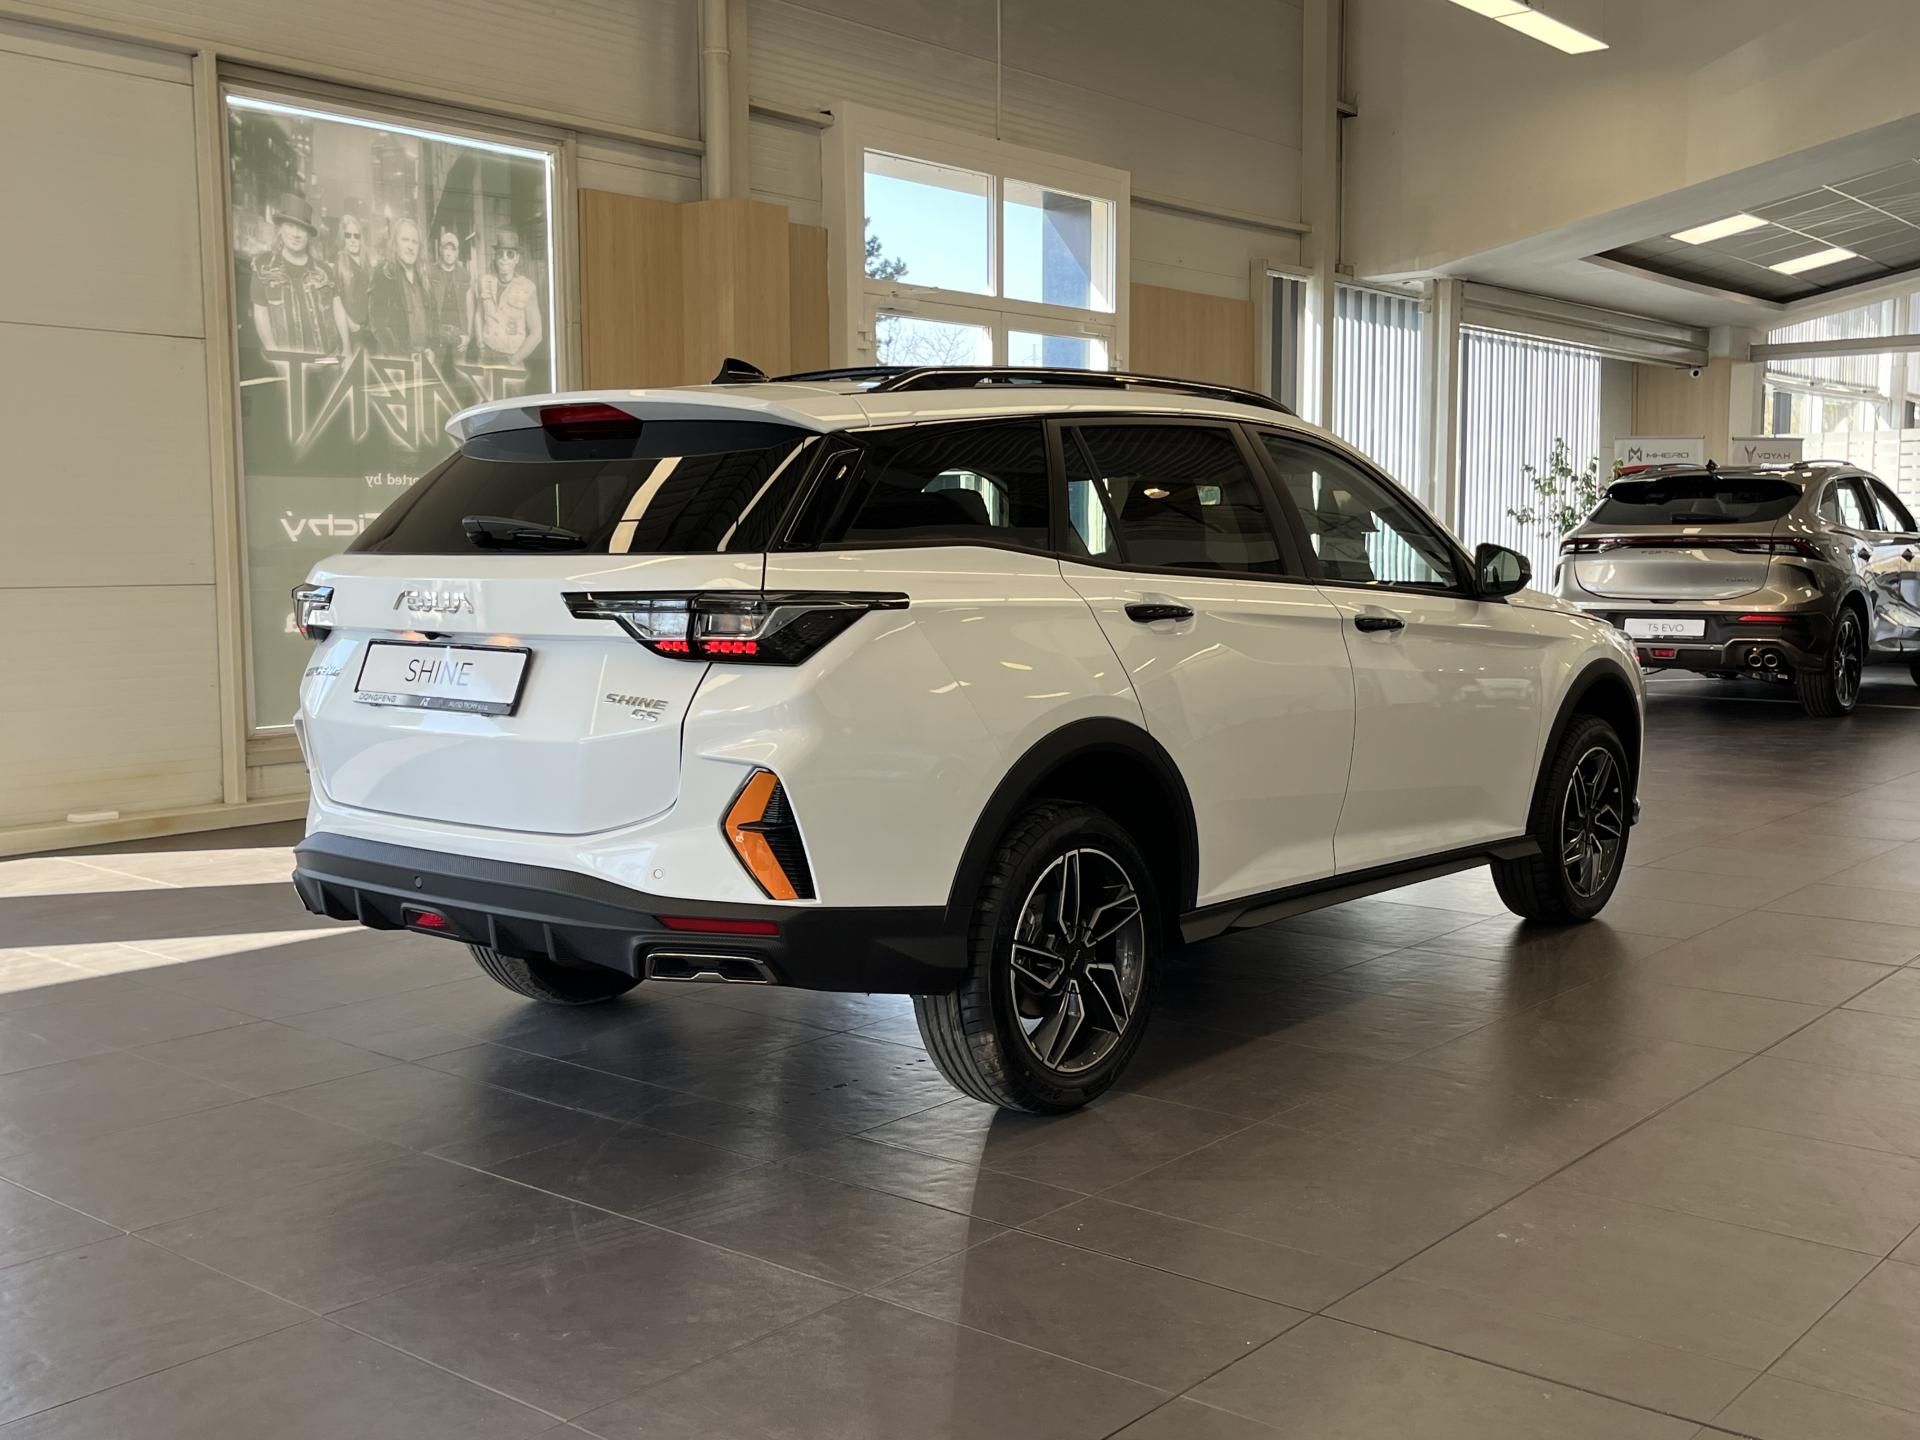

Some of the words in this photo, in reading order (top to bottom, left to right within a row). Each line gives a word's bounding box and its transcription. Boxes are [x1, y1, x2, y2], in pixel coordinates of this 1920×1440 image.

[1647, 623, 1659, 632] T5
[1661, 623, 1685, 633] EVO
[404, 658, 474, 687] SHINE
[358, 692, 398, 703] DONGFENG
[603, 693, 669, 711] SHINE
[631, 708, 661, 722] GS
